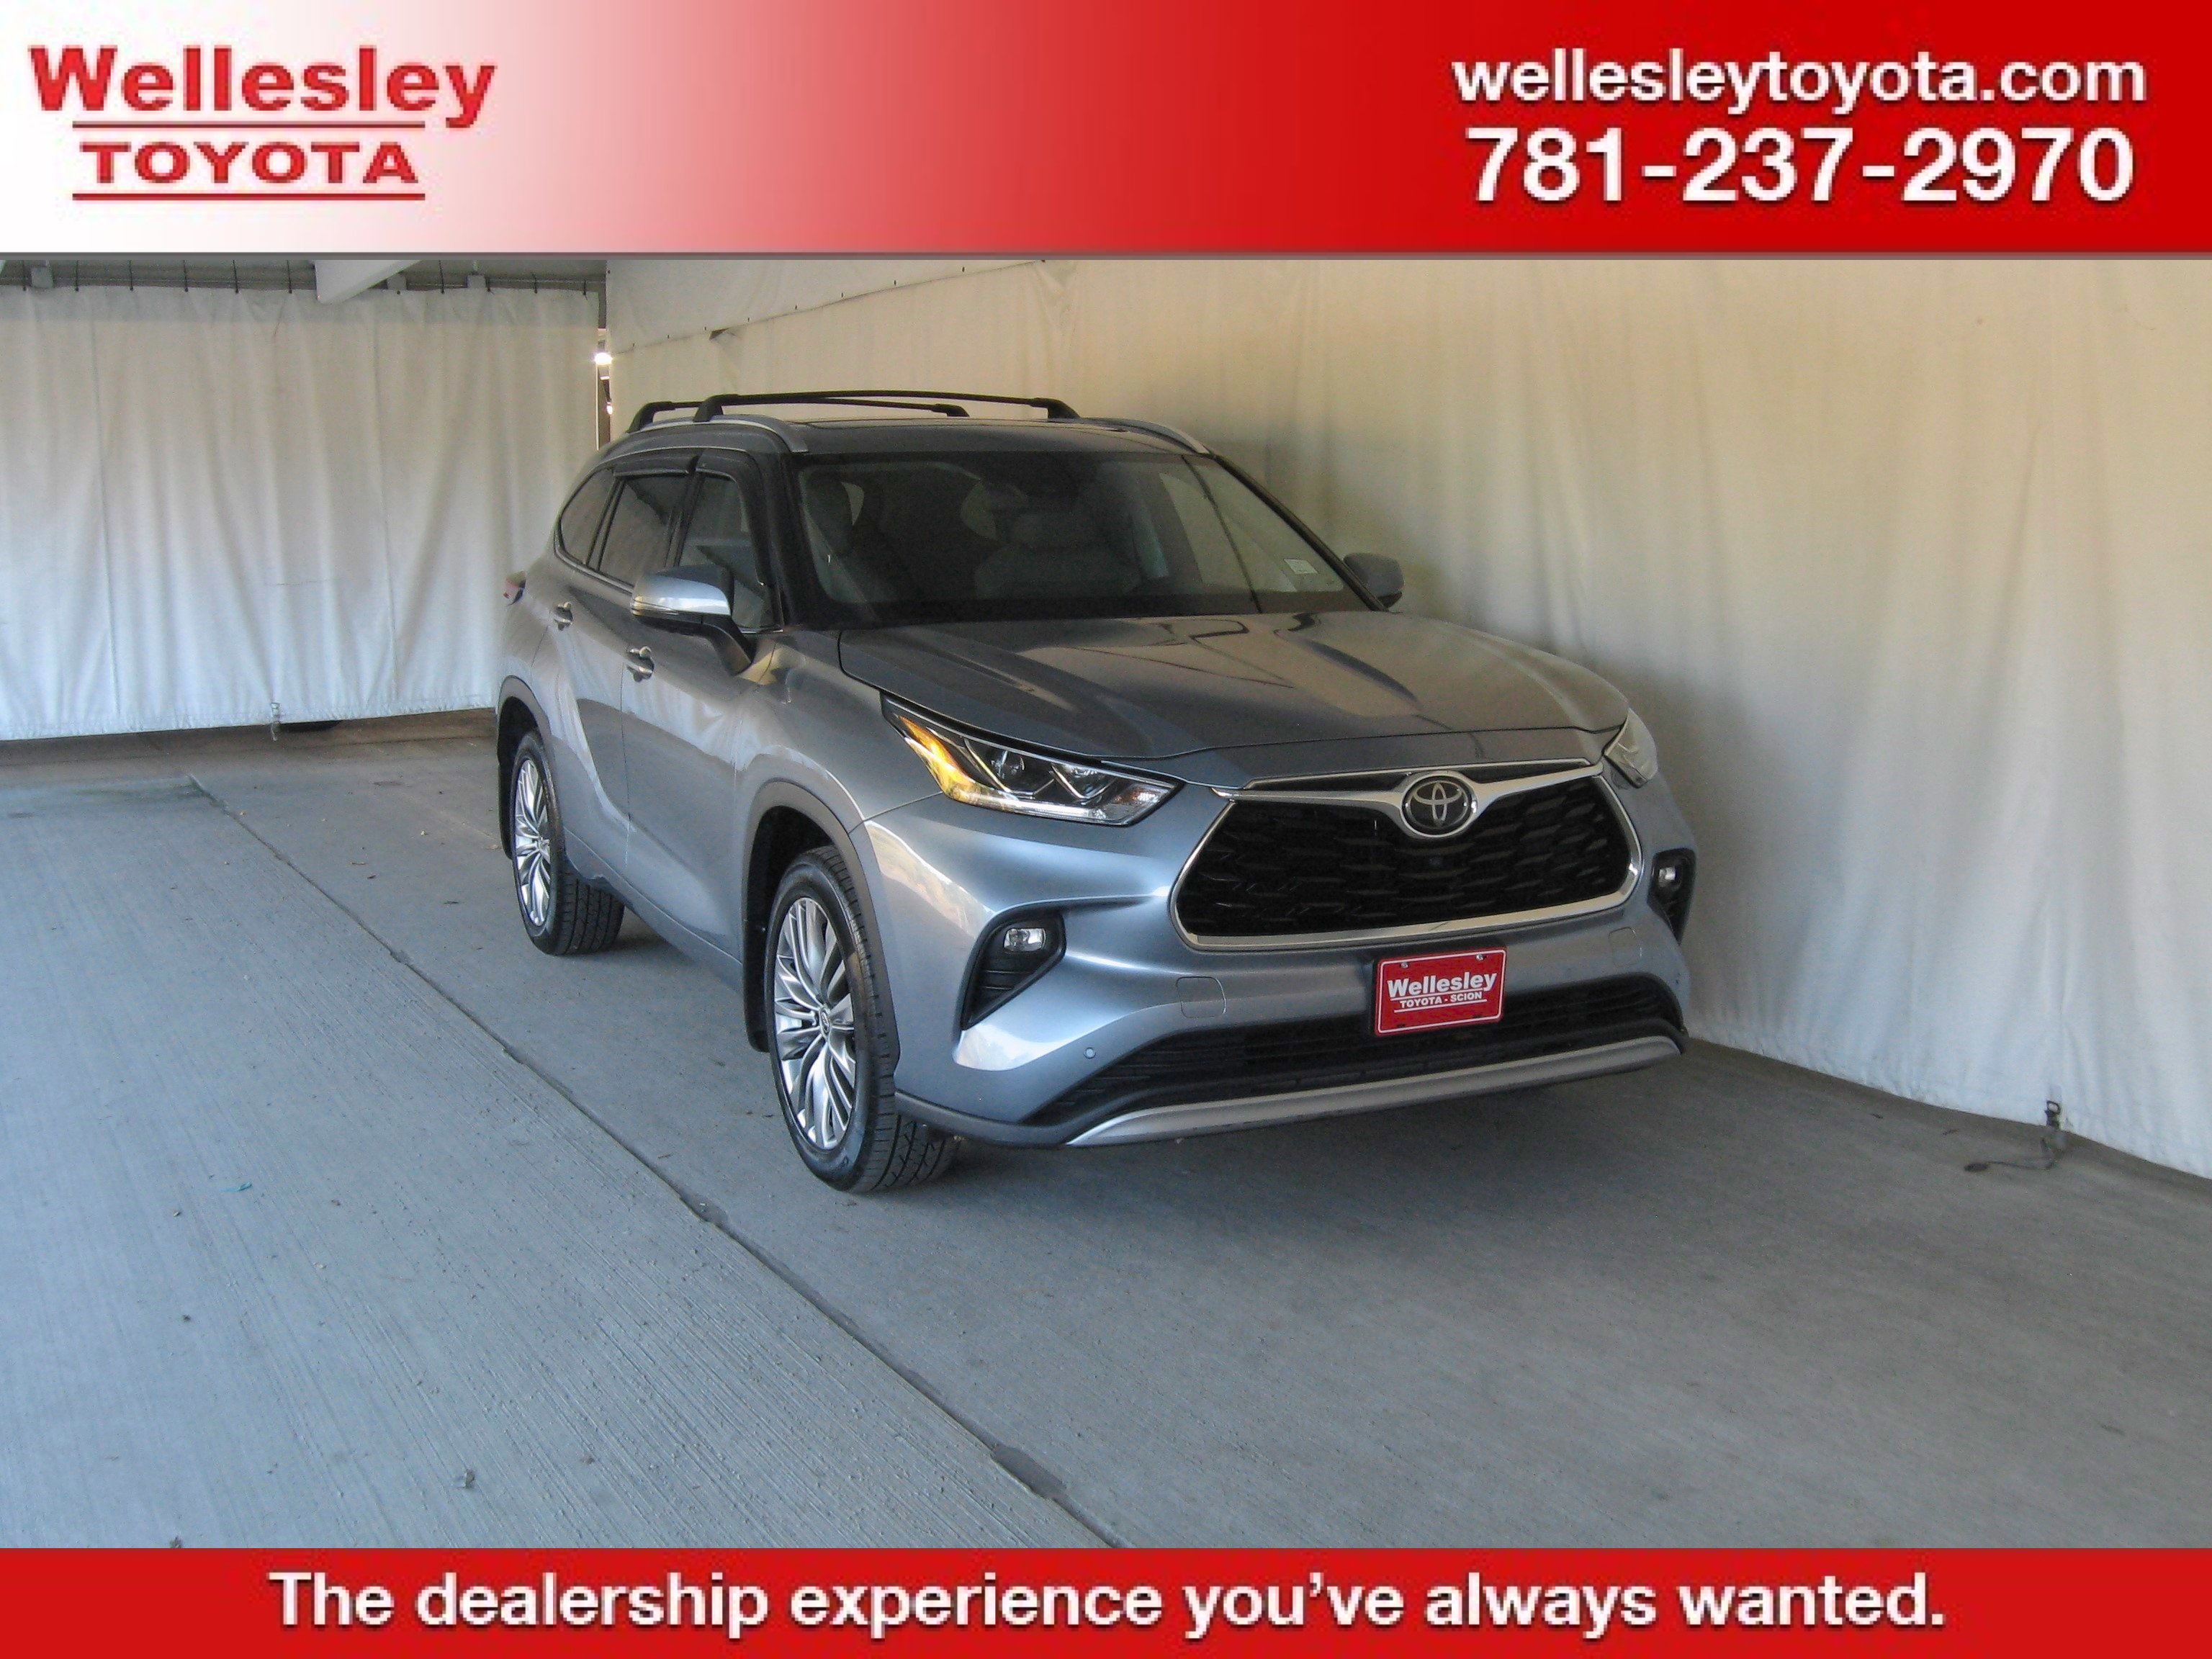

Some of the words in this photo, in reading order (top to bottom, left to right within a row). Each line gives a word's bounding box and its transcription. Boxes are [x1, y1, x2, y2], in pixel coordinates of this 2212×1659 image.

[1387, 971, 1497, 998] Wellesley
[1399, 996, 1442, 1009] TOYOTA
[1450, 992, 1483, 1003] SCION
